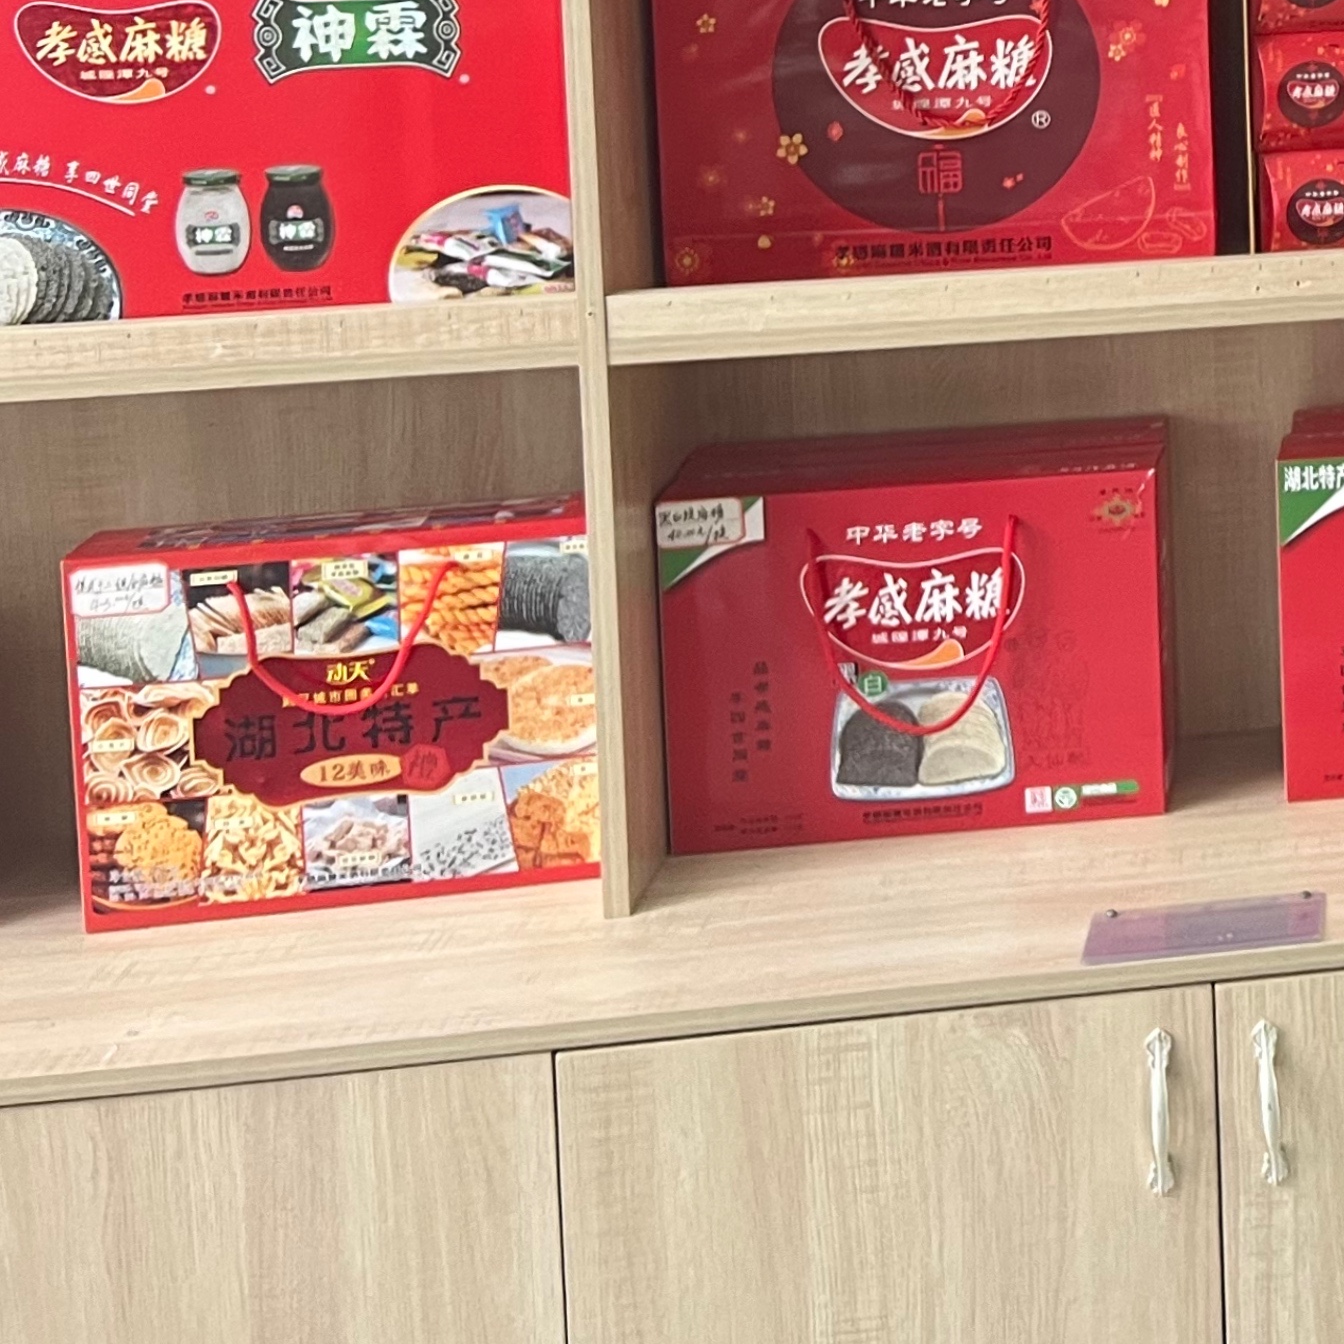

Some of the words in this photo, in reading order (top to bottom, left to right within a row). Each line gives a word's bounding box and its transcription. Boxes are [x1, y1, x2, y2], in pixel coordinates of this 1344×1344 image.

[35, 17, 208, 66] 孝感麻糖
[291, 2, 428, 62] 神霖
[843, 34, 1037, 94] 孝感麻糖
[845, 518, 982, 545] 中华老字号
[823, 567, 1010, 628] 孝感麻糖
[224, 694, 483, 764] 湖北特产
